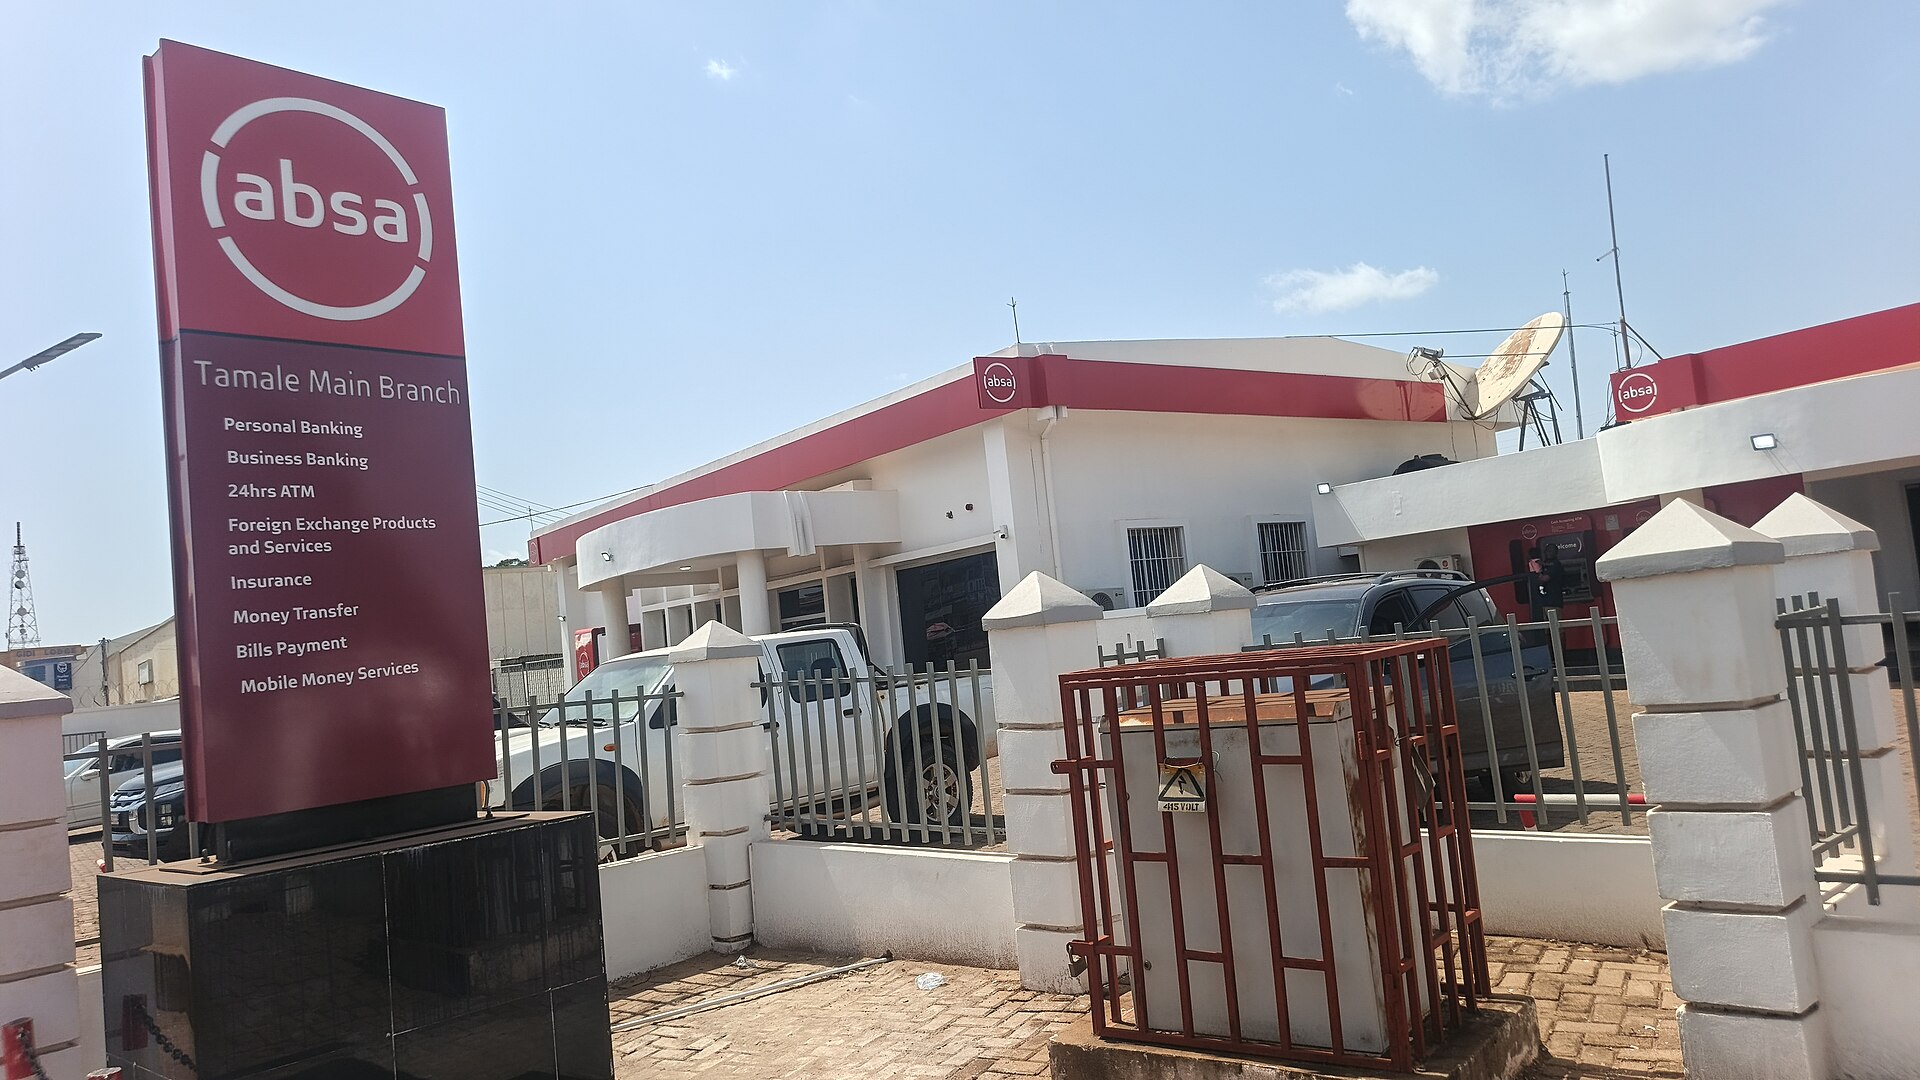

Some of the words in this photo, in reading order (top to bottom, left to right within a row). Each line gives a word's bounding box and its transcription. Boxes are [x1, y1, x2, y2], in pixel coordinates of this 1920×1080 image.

[234, 157, 411, 242] absa
[193, 359, 300, 392] Tamale
[309, 369, 371, 397] Main
[379, 375, 460, 405] Branch
[987, 374, 1013, 387] absa
[1623, 386, 1653, 400] absa
[224, 417, 297, 433] Personal
[300, 420, 363, 439] Banking
[227, 450, 303, 465] Business
[306, 452, 369, 471] Banking
[228, 483, 277, 498] 24hrs
[280, 484, 315, 498] ATM
[228, 517, 292, 535] Foreign
[296, 516, 369, 533] Exchange
[372, 515, 436, 530] Products
[228, 539, 260, 555] and
[264, 538, 332, 554] Services
[1555, 542, 1577, 550] elcome
[231, 575, 312, 590] Insurance
[233, 610, 290, 625] Money
[292, 602, 359, 620] Transfer
[236, 642, 273, 659] Bills
[276, 636, 348, 657] Payment
[241, 674, 298, 694] Mobile
[302, 671, 354, 687] Money
[357, 663, 419, 680] Services
[1163, 803, 1179, 811] 415
[1180, 803, 1200, 811] VOLT
